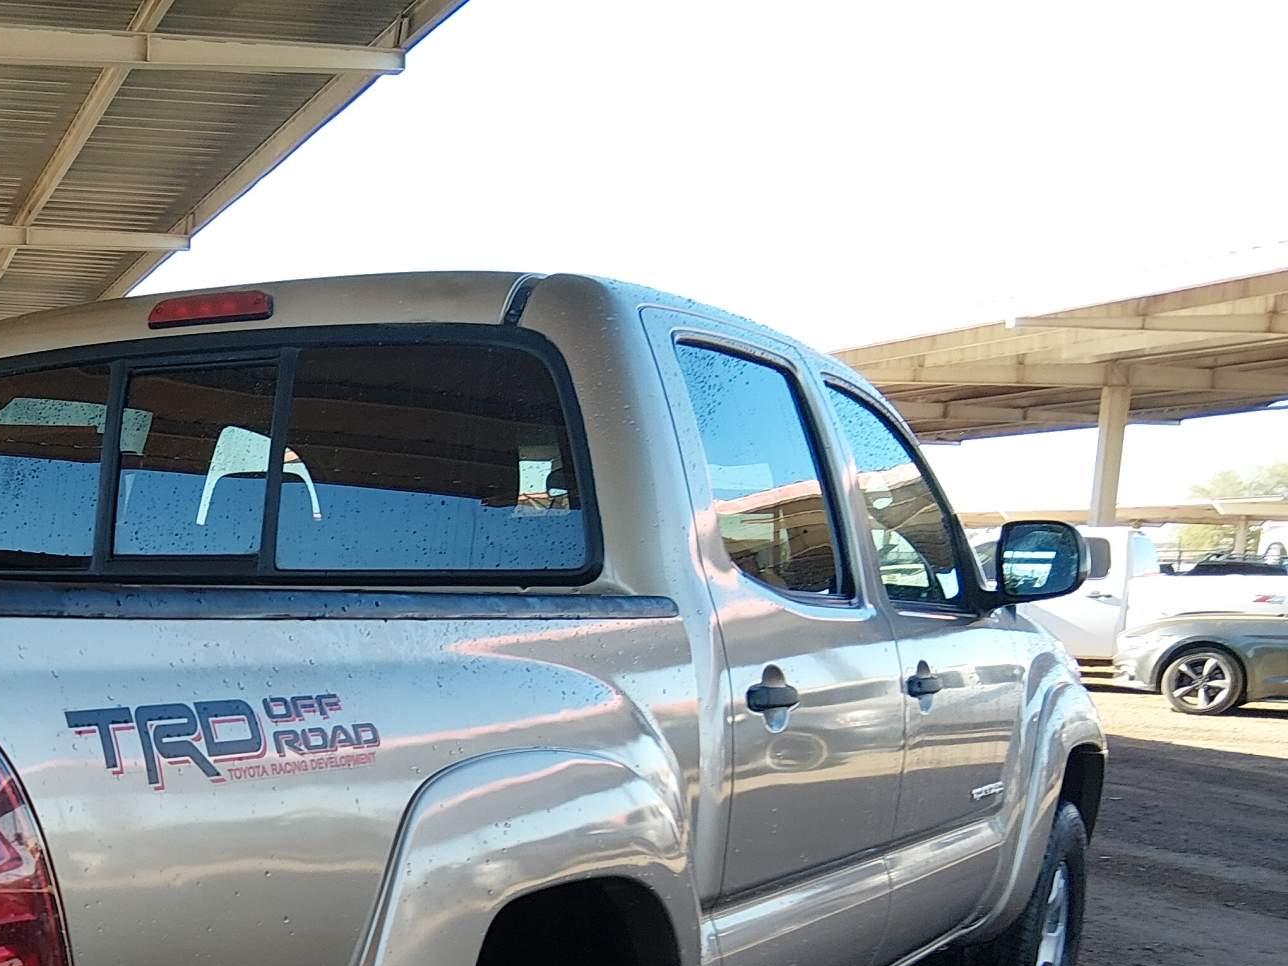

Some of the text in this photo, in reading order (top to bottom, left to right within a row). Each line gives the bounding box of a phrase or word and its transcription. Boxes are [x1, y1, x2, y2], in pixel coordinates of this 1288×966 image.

[262, 693, 343, 723] OFF
[64, 699, 268, 790] TRD
[272, 722, 381, 758] ROAD
[227, 751, 377, 781] TOYOTA RACING DEVELOPMENT
